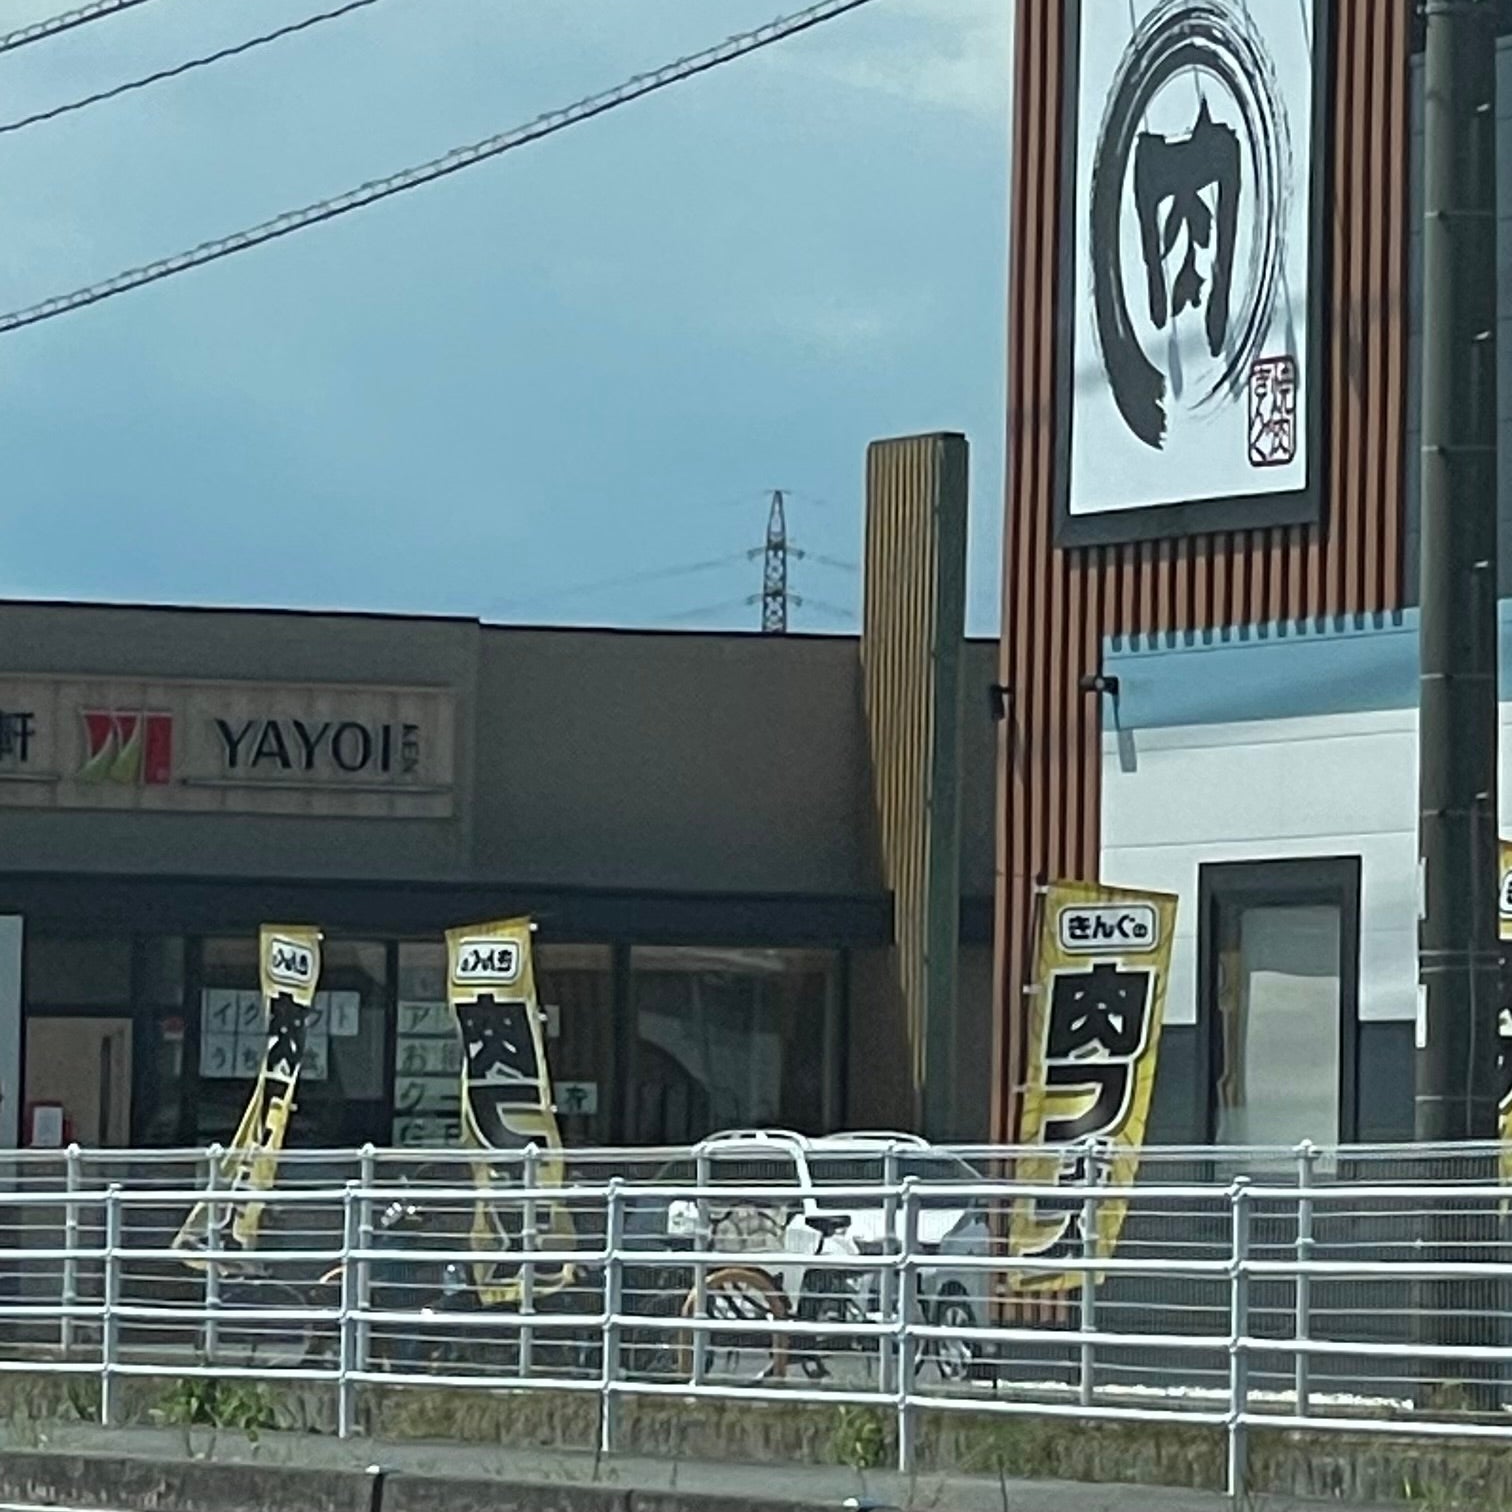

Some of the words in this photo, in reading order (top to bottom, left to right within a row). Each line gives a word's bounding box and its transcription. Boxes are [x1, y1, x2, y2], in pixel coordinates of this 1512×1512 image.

[1133, 91, 1242, 358] 肉
[214, 718, 392, 773] YAYOI
[401, 723, 420, 775] KEN
